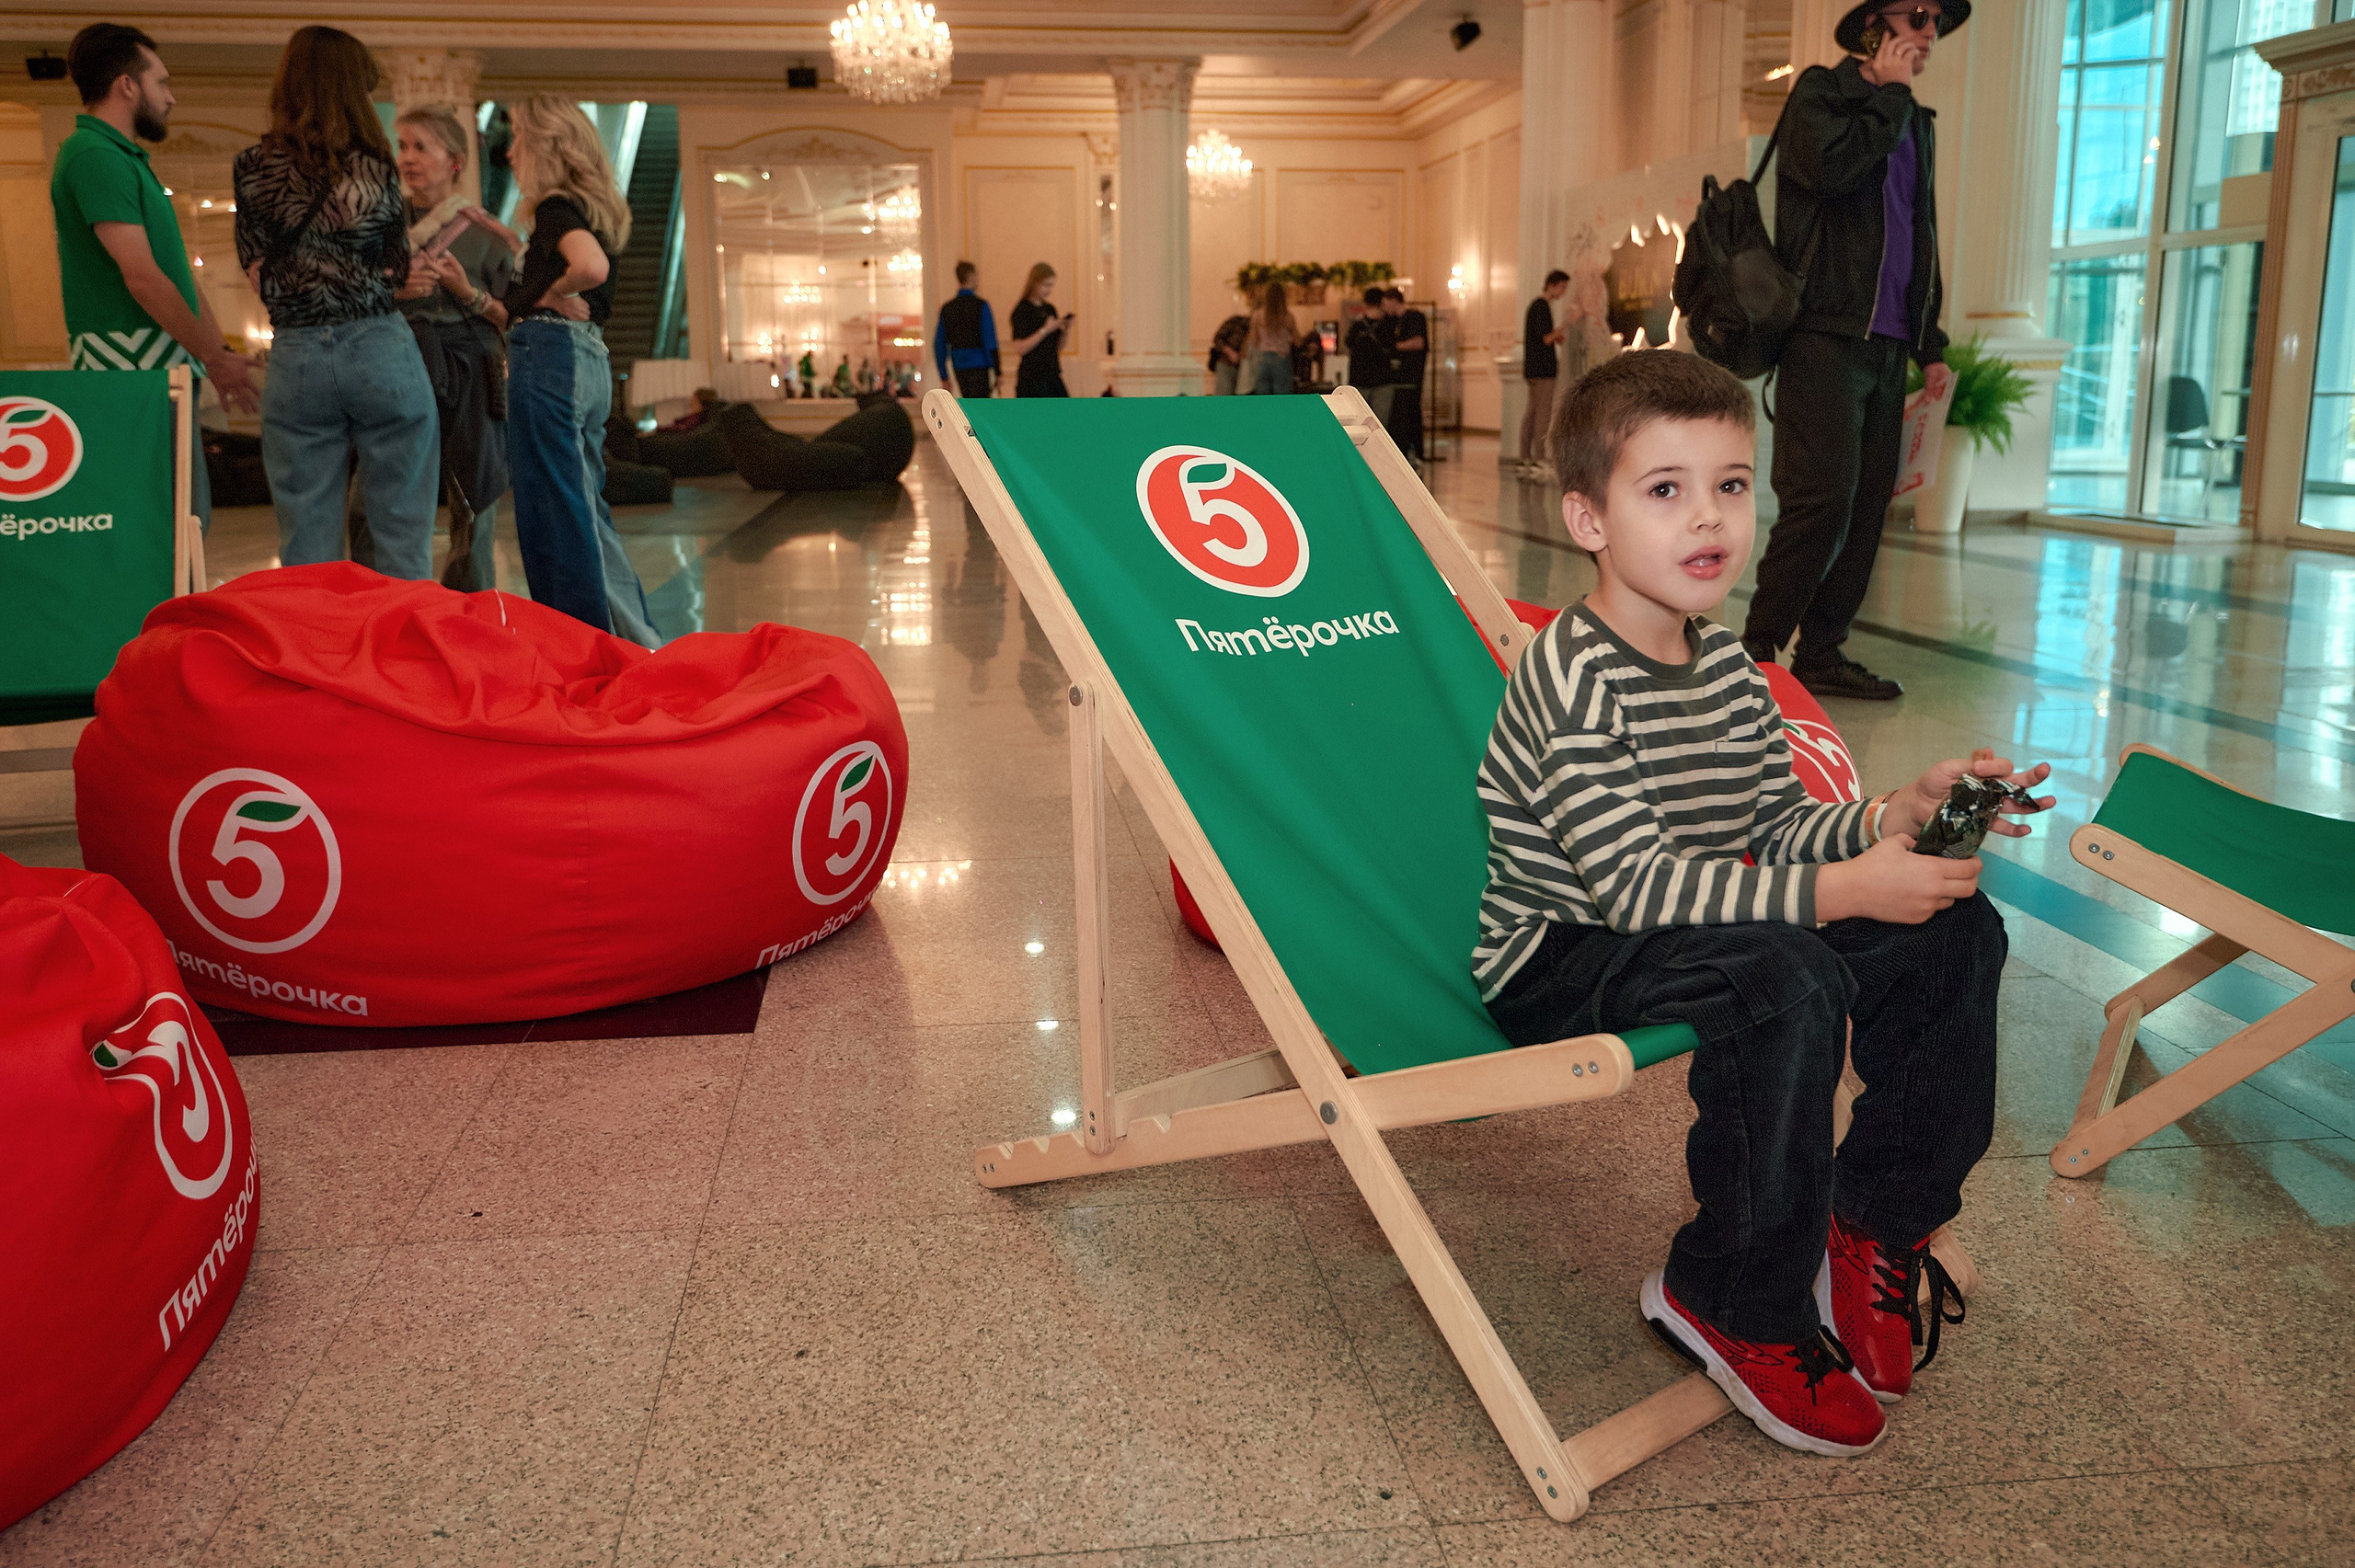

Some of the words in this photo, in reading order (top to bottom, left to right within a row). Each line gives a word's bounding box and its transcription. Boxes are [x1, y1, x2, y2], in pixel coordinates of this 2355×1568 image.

[0, 513, 114, 541] ёрочка
[1178, 457, 1268, 567] 5
[1175, 610, 1399, 657] Пятёрочка
[206, 791, 308, 919] 5
[825, 751, 874, 876] 5
